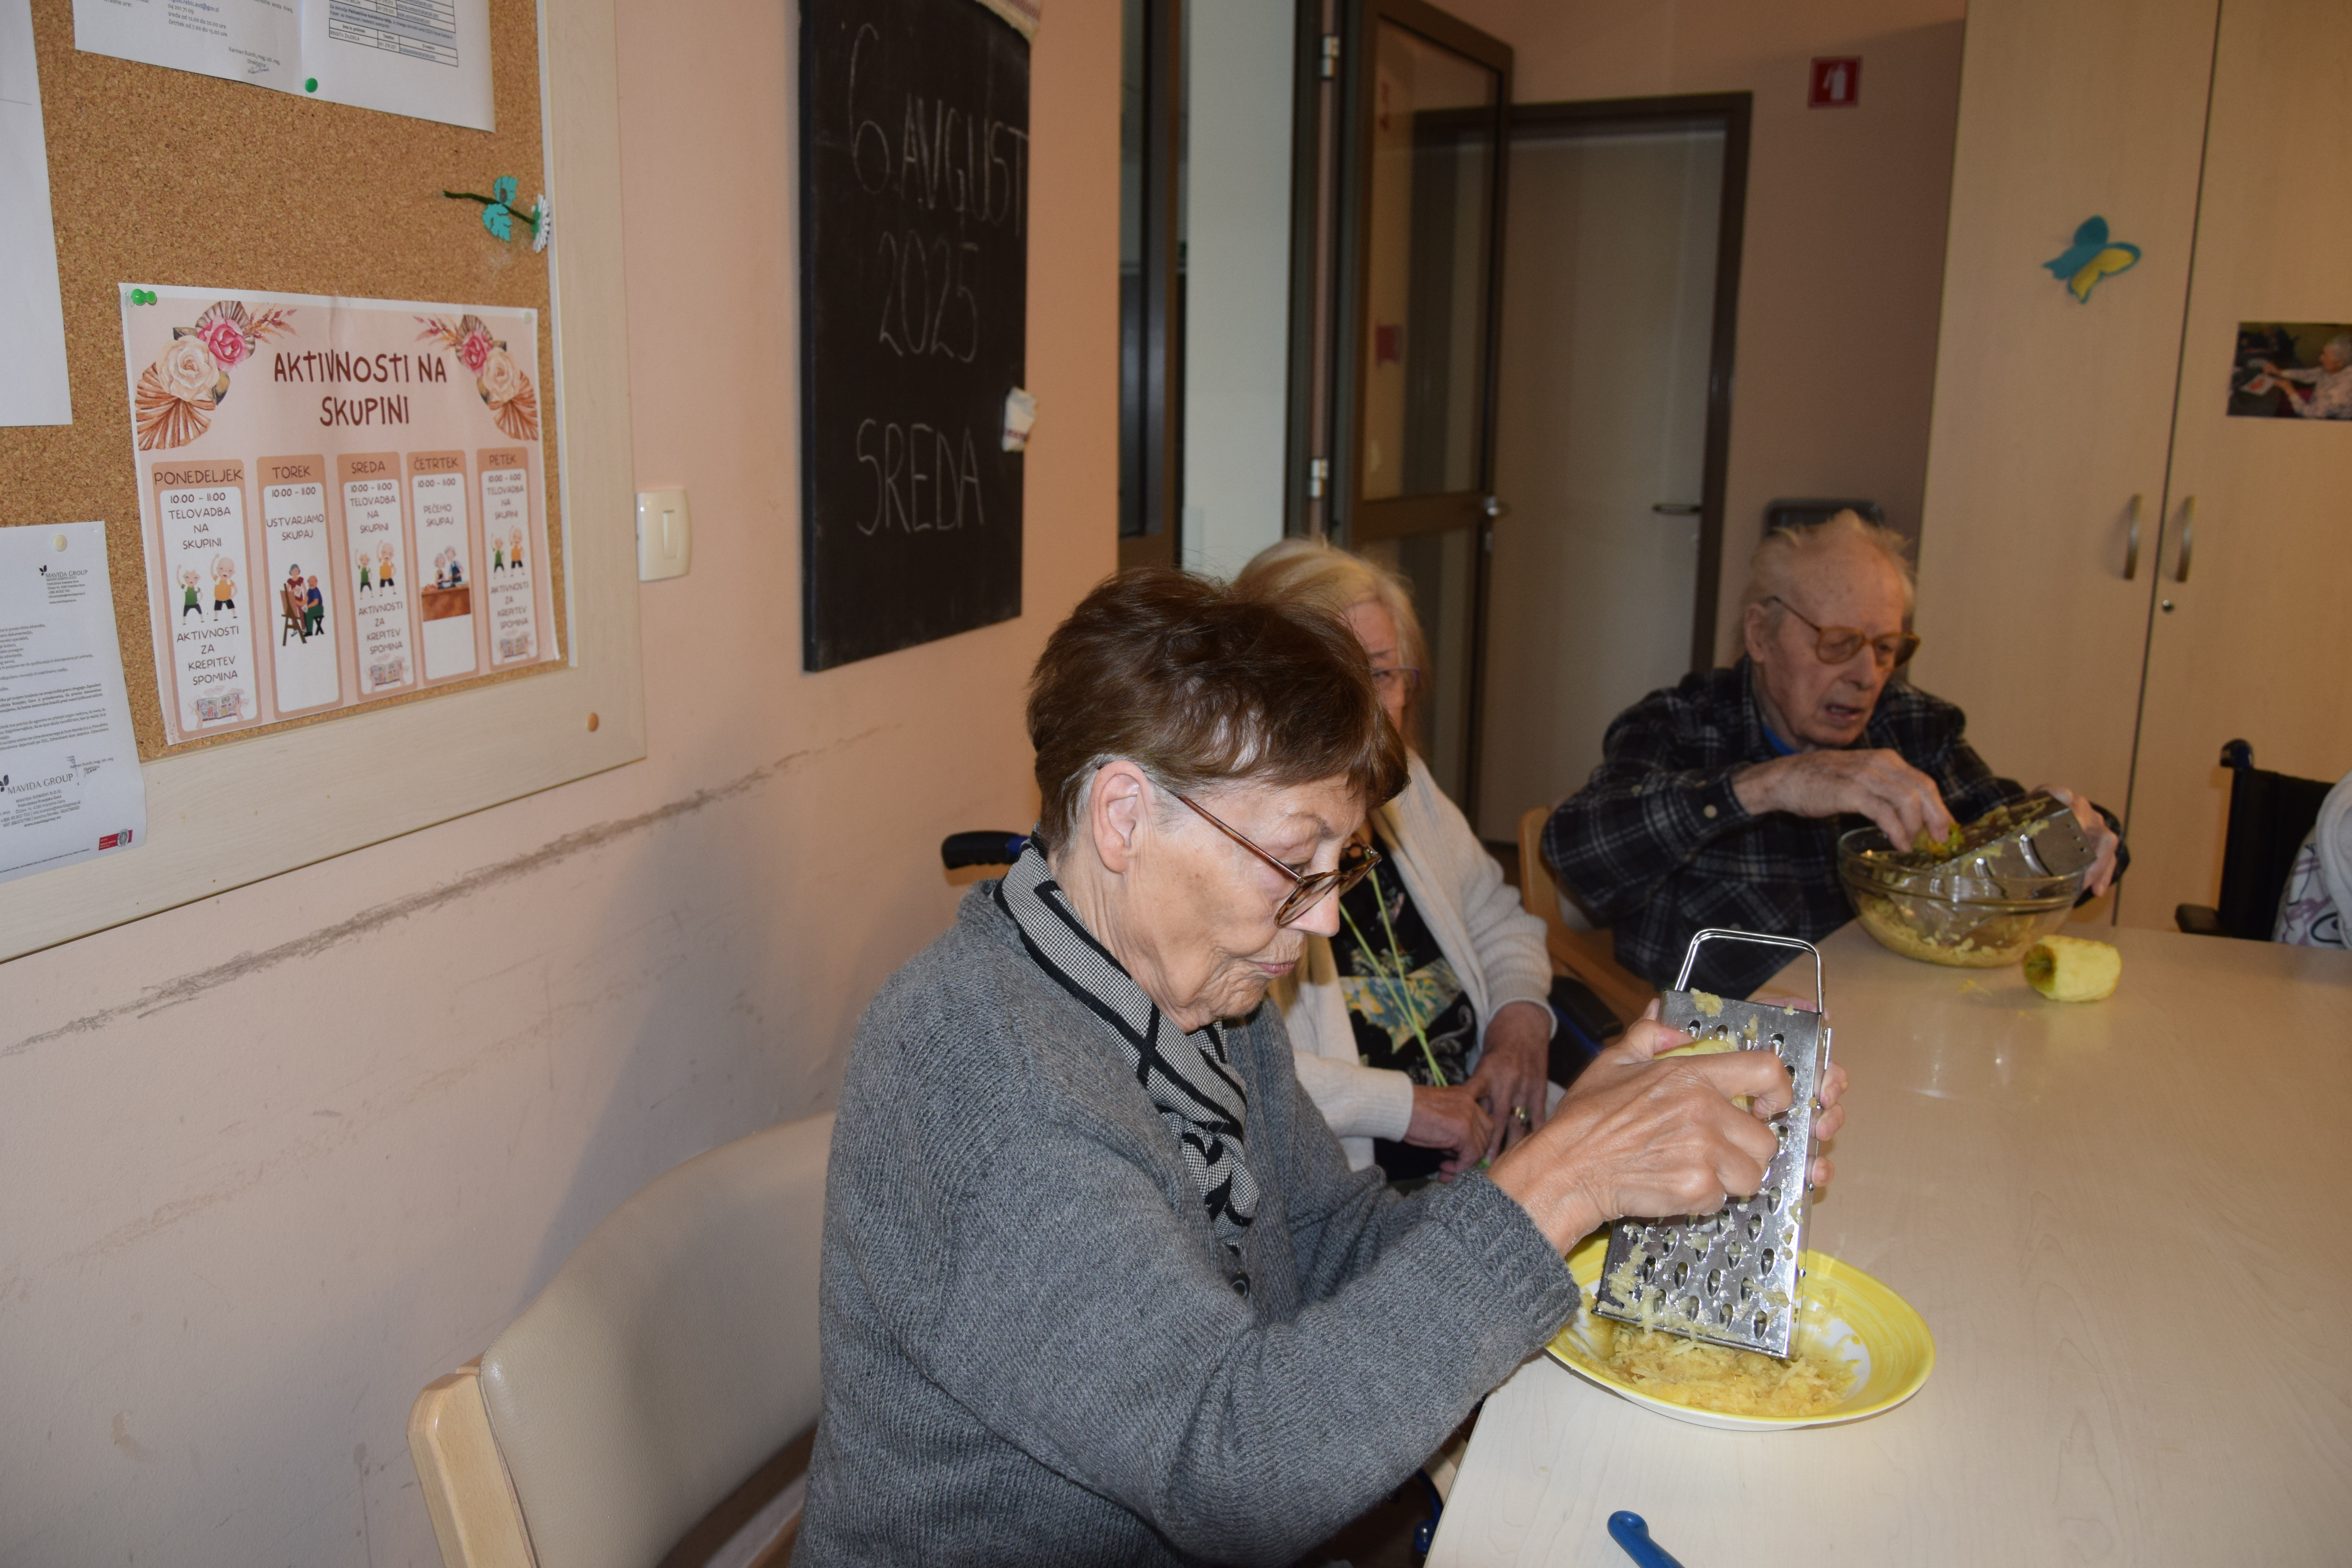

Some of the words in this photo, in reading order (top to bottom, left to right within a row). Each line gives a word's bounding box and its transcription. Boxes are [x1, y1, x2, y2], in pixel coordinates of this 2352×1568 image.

[901, 92, 1029, 238] AVGUST
[879, 230, 980, 363] 2025
[274, 349, 409, 383] AKTIVNOSTI
[417, 352, 447, 383] NA
[320, 394, 409, 426] SKUPINI
[414, 456, 459, 471] ČETRTEK
[488, 454, 517, 466] PETEK
[272, 465, 311, 480] TOREK
[351, 461, 386, 474] SREDA
[154, 469, 243, 485] PONEDELJEK
[417, 479, 435, 488] 10:00
[442, 478, 456, 486] 11:00
[488, 474, 503, 483] 10:00
[856, 418, 984, 537] SREDA
[272, 488, 292, 497] 10:00
[301, 486, 316, 495] 11:00
[350, 484, 368, 493] 10:00
[377, 482, 392, 491] 11:00
[487, 485, 524, 495] TELOVADBA
[171, 494, 194, 504] 10:00
[207, 492, 226, 502] 11:00
[350, 495, 396, 506] TELOVADBA
[169, 507, 231, 520] TELOVADBA
[367, 510, 379, 519] NA
[423, 503, 452, 514] PEČEMO
[266, 514, 324, 528] USTVARJAMO
[495, 510, 518, 520] SKUPINI
[426, 517, 454, 527] SKUPAJ
[194, 524, 209, 534] NA
[359, 523, 389, 534] SKUPINI
[282, 530, 314, 541] SKUPAJ
[183, 538, 222, 549] SKUPINI
[490, 581, 528, 593] AKTIVNOSTI
[358, 601, 403, 616] AKTIVNOSTI
[497, 606, 527, 617] KREPITEV
[375, 618, 385, 627] ZA
[500, 617, 528, 630] SPOMINA
[177, 626, 239, 642] AKTIVNOSTI
[367, 628, 401, 641] KREPITEV
[201, 644, 215, 654] ZA
[370, 641, 403, 655] SPOMINA
[188, 655, 236, 671] KREPITEV
[193, 670, 238, 686] SPOMINA
[8, 781, 42, 795] MAVIDA
[44, 773, 73, 786] GROUP
